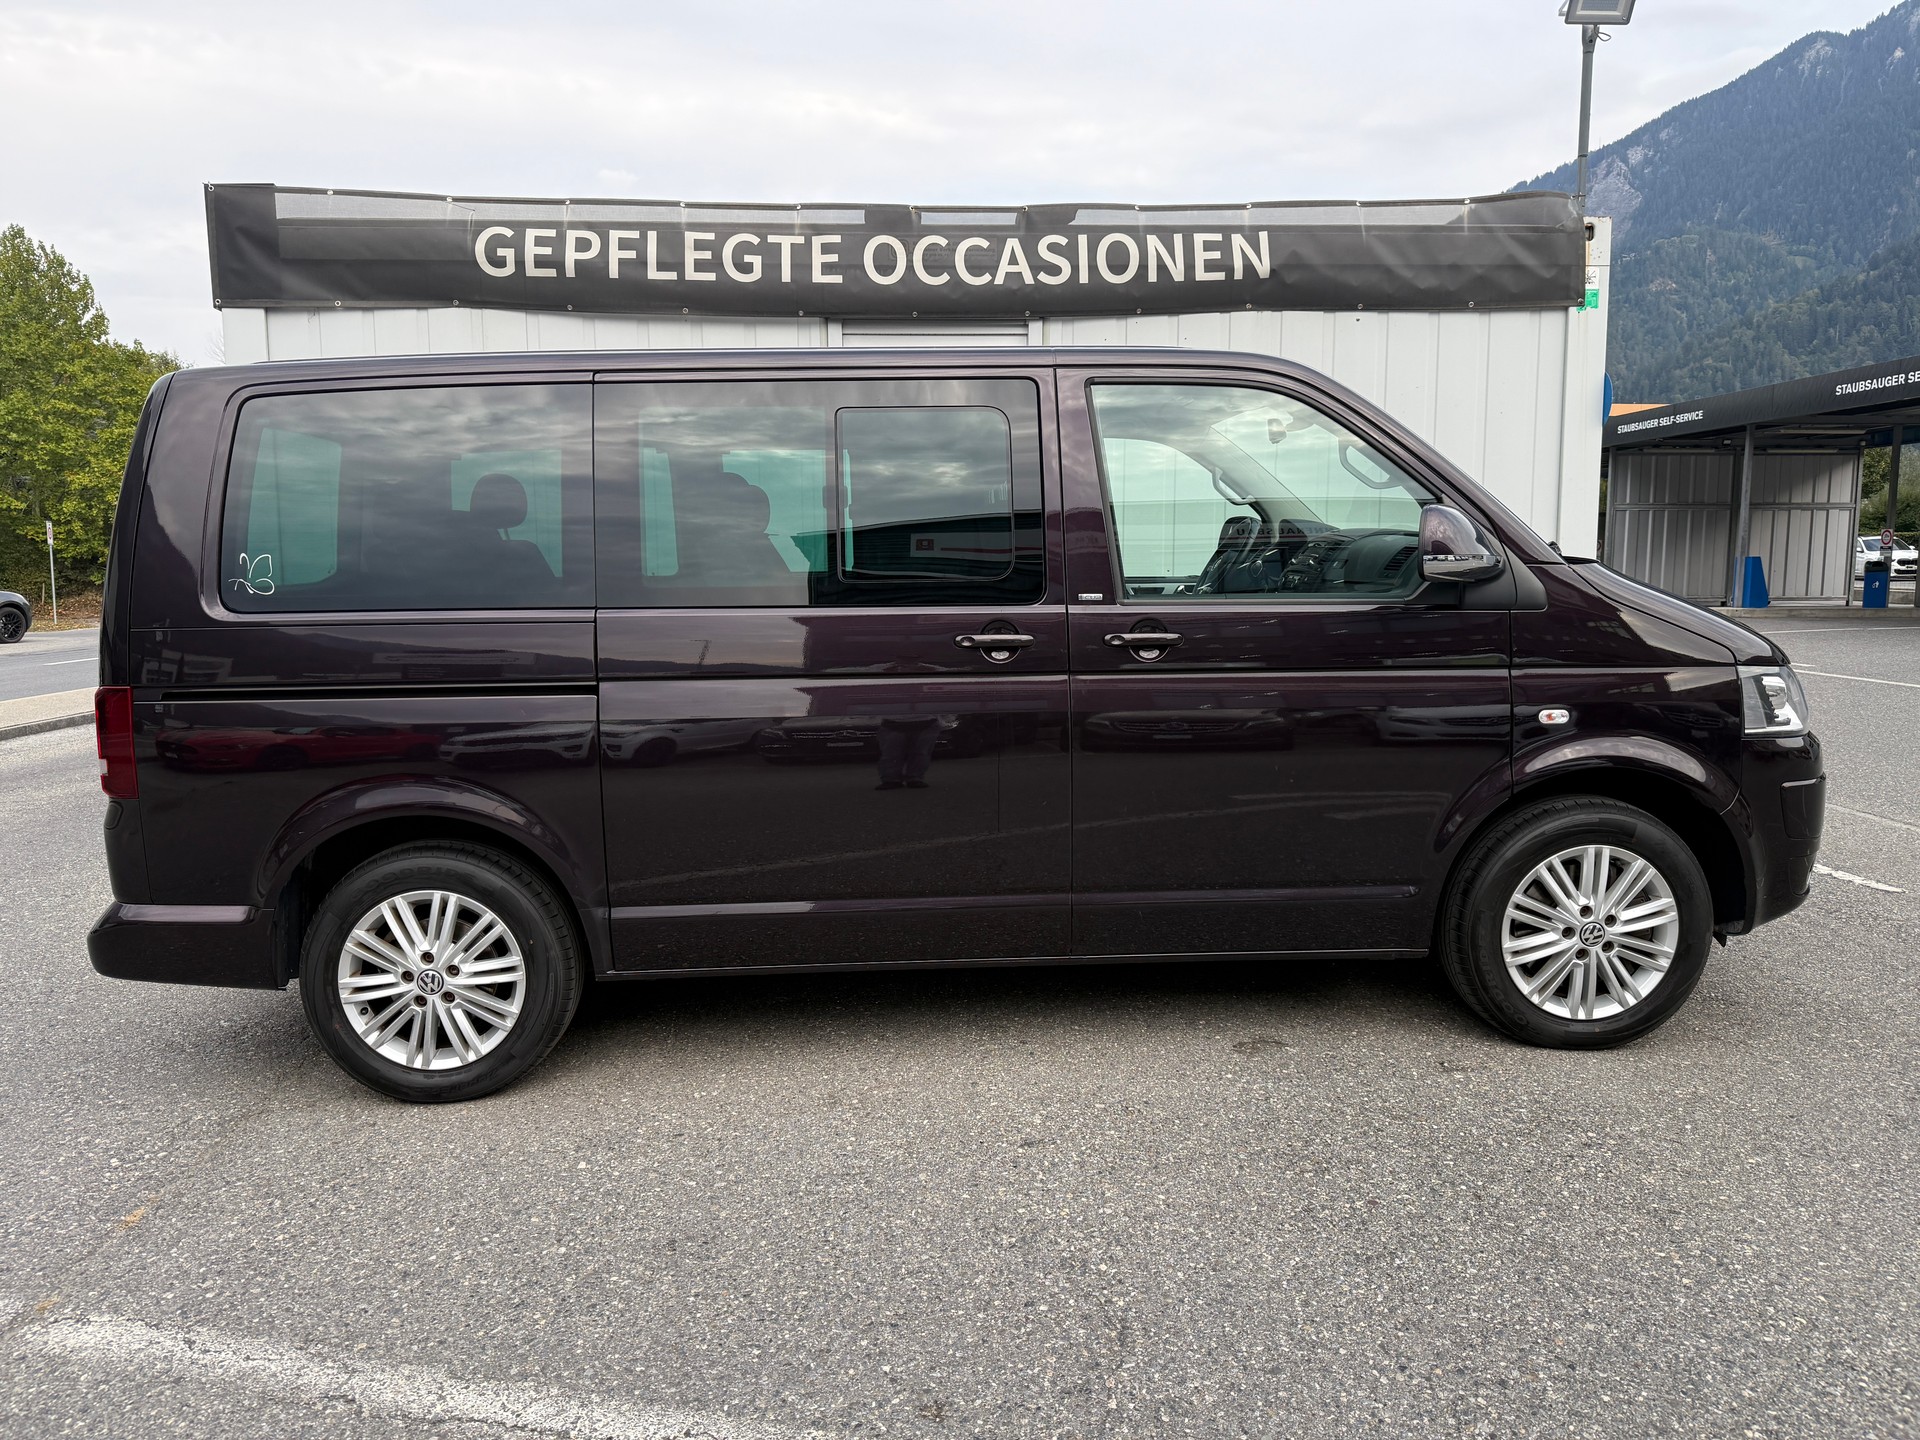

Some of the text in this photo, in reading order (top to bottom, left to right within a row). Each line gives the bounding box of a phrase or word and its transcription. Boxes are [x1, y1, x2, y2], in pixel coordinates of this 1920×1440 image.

[475, 226, 1271, 286] GEPFLEGTE OCCASIONEN
[1835, 373, 1905, 396] STAUBSAUGER
[1617, 410, 1704, 434] STAUBSAUGER SELF-SERVICE
